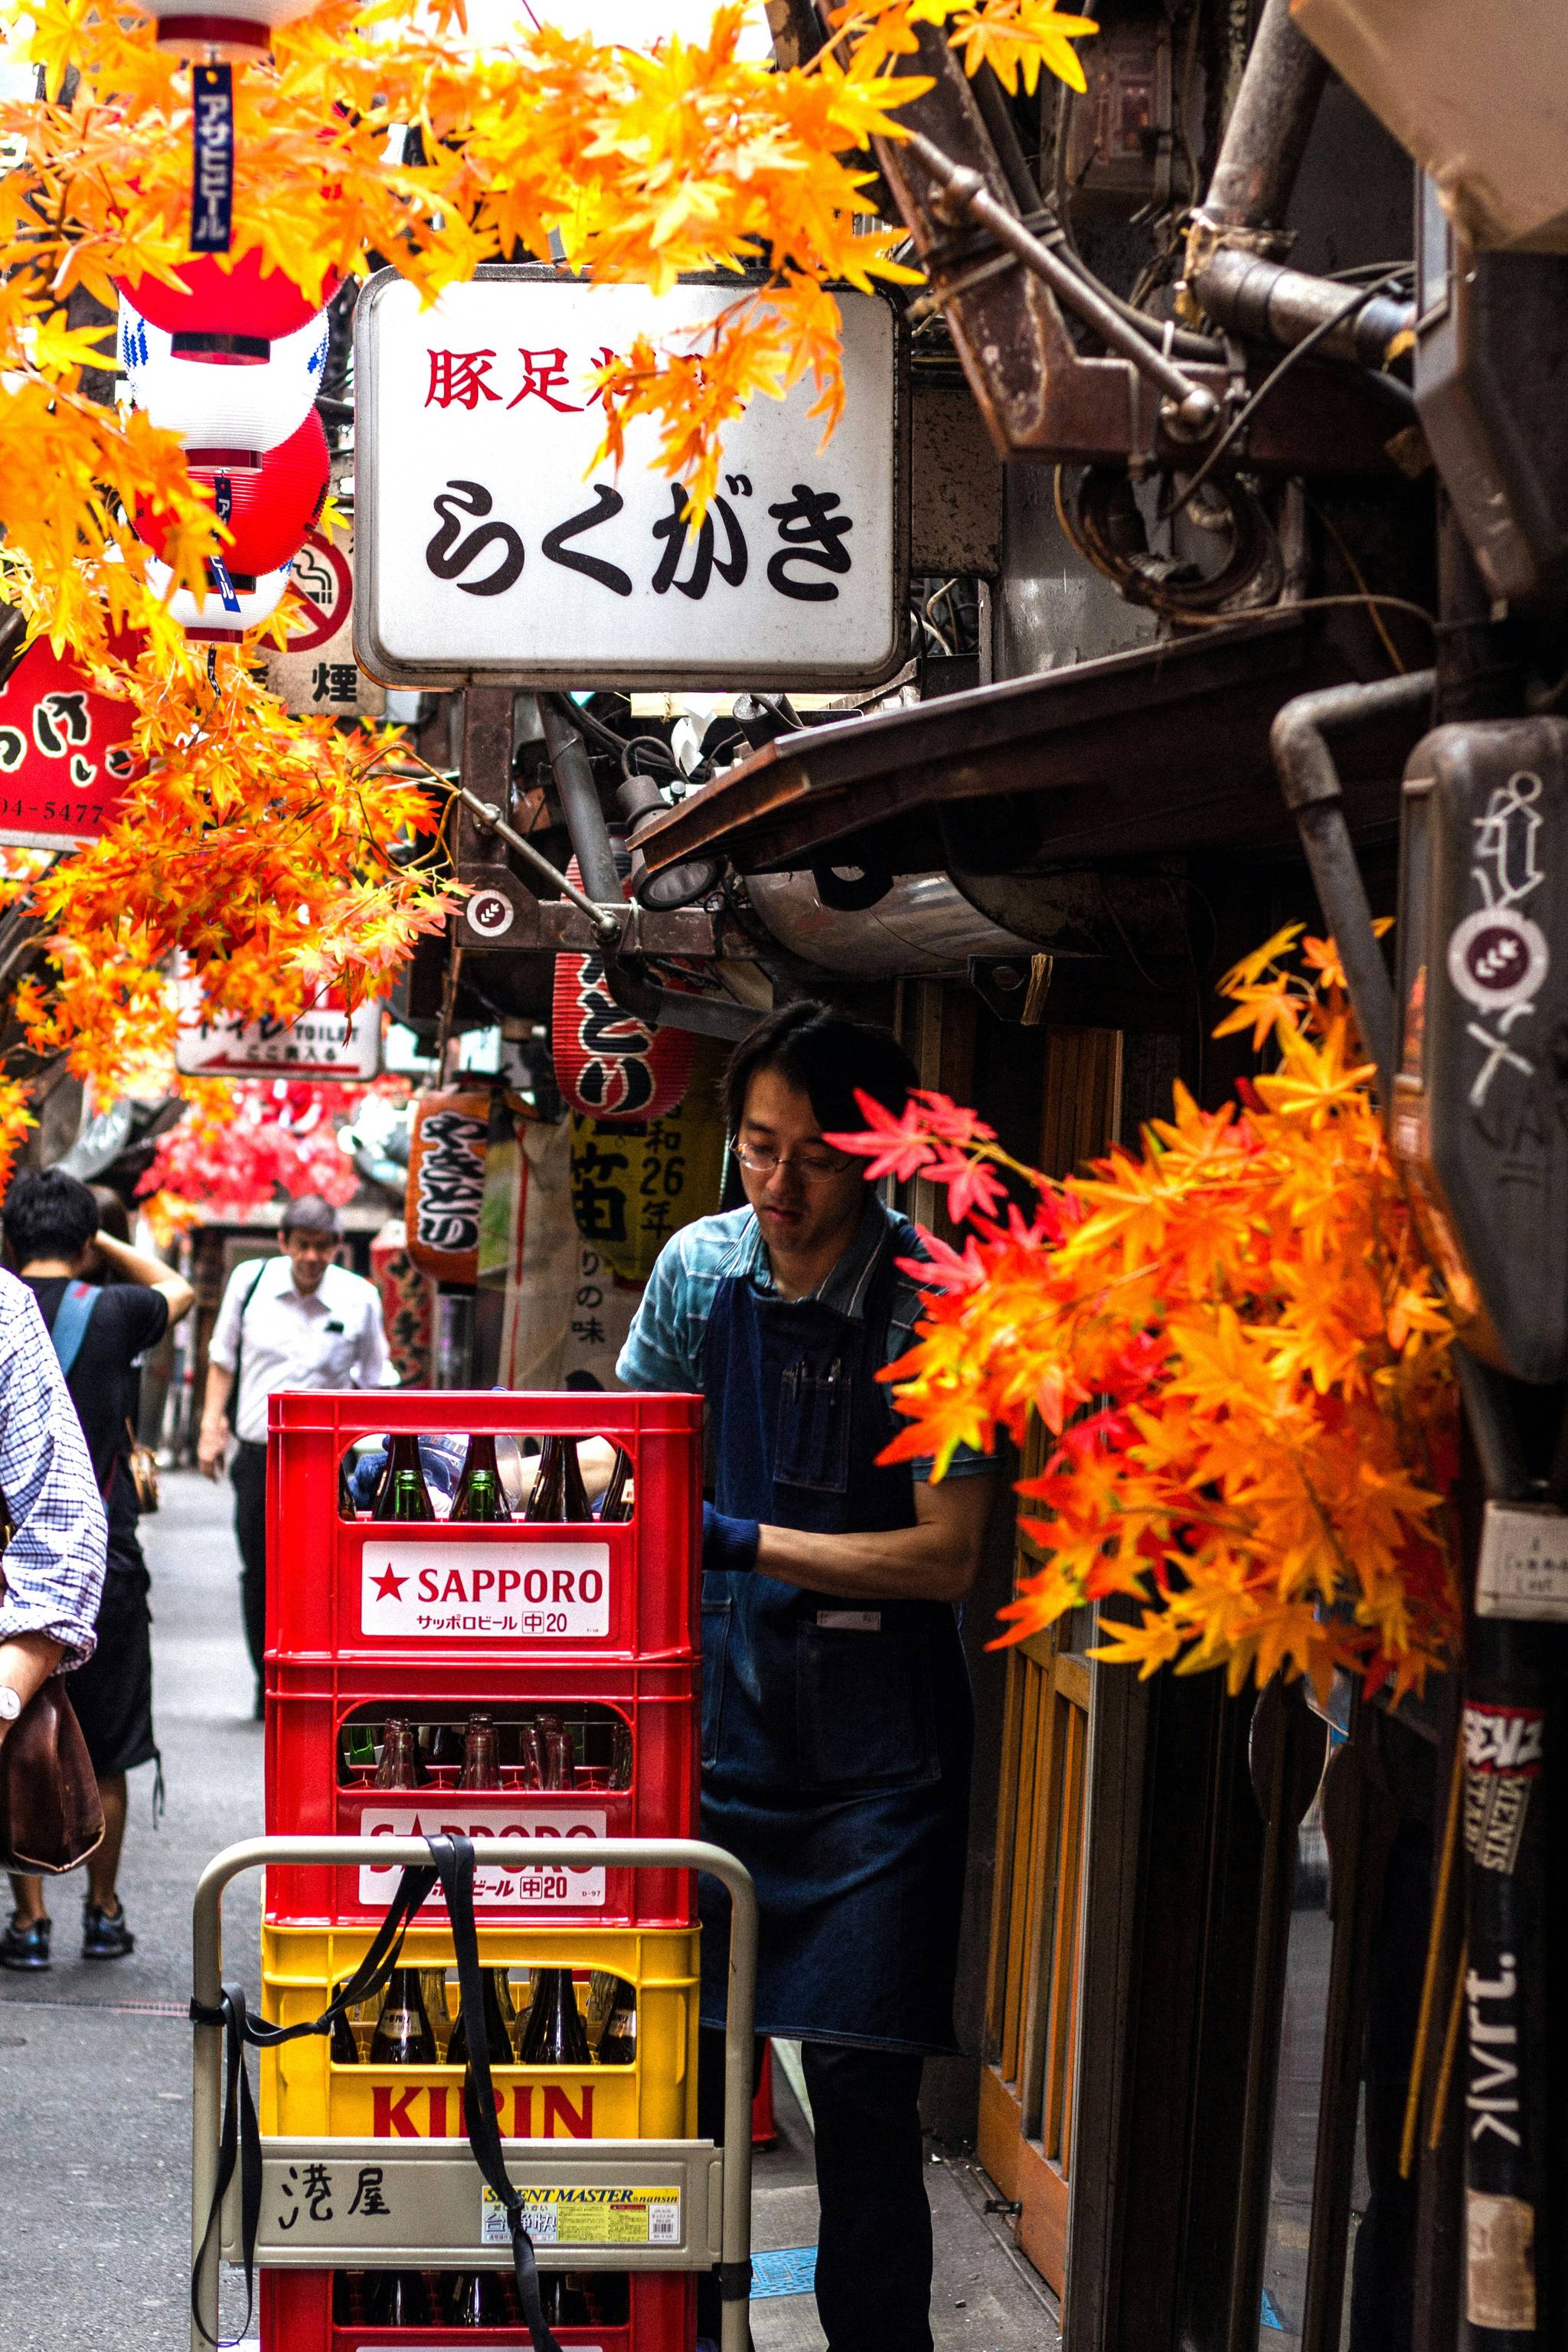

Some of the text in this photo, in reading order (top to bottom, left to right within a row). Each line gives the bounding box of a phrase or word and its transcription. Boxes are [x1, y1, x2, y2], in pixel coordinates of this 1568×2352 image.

[424, 347, 746, 414] 豚足
[426, 473, 854, 602] らくがき
[417, 1568, 603, 1603] SAPPORO
[278, 2163, 390, 2230] 港屋
[556, 2188, 634, 2203] MASTER
